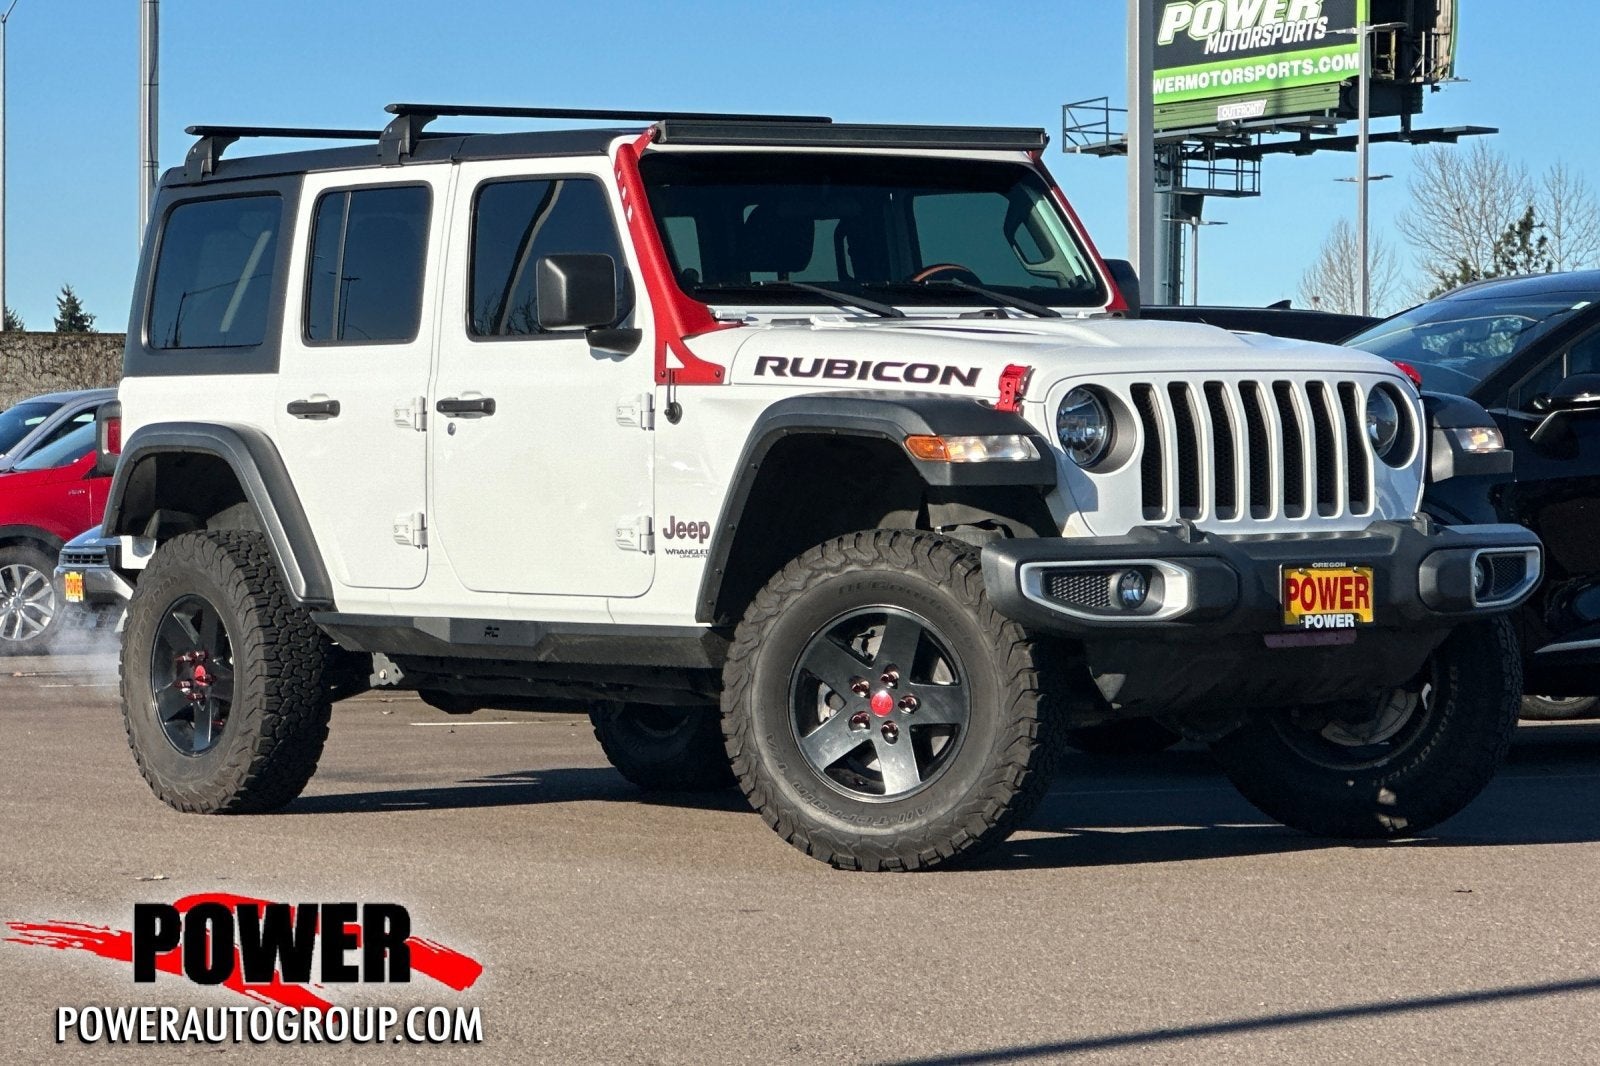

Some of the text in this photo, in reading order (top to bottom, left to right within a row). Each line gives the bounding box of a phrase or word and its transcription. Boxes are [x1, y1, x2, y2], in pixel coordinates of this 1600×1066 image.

[1204, 16, 1328, 54] MOTORSPORTS
[754, 356, 982, 387] RUBICON
[663, 515, 711, 544] Jeep
[1285, 576, 1369, 611] POWER
[1305, 614, 1354, 629] POWER
